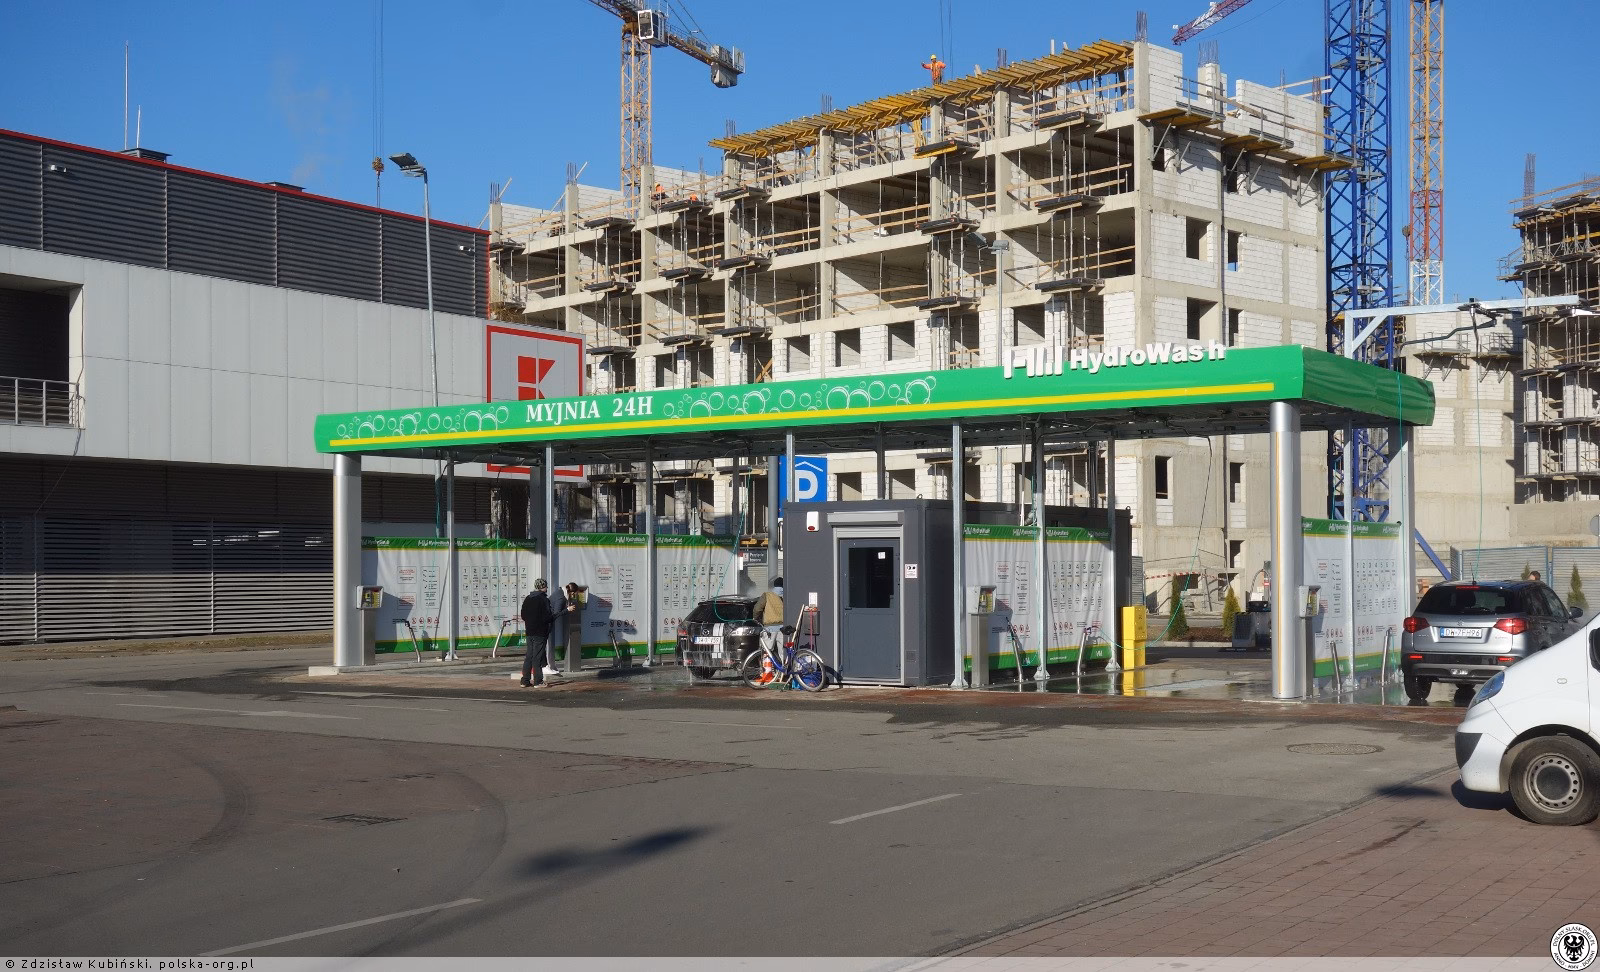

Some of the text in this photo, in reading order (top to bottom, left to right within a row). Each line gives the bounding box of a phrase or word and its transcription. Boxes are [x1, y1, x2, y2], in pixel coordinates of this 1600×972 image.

[1070, 339, 1226, 374] HydroWash
[526, 396, 654, 426] MYJNIA 24H
[794, 469, 818, 502] P
